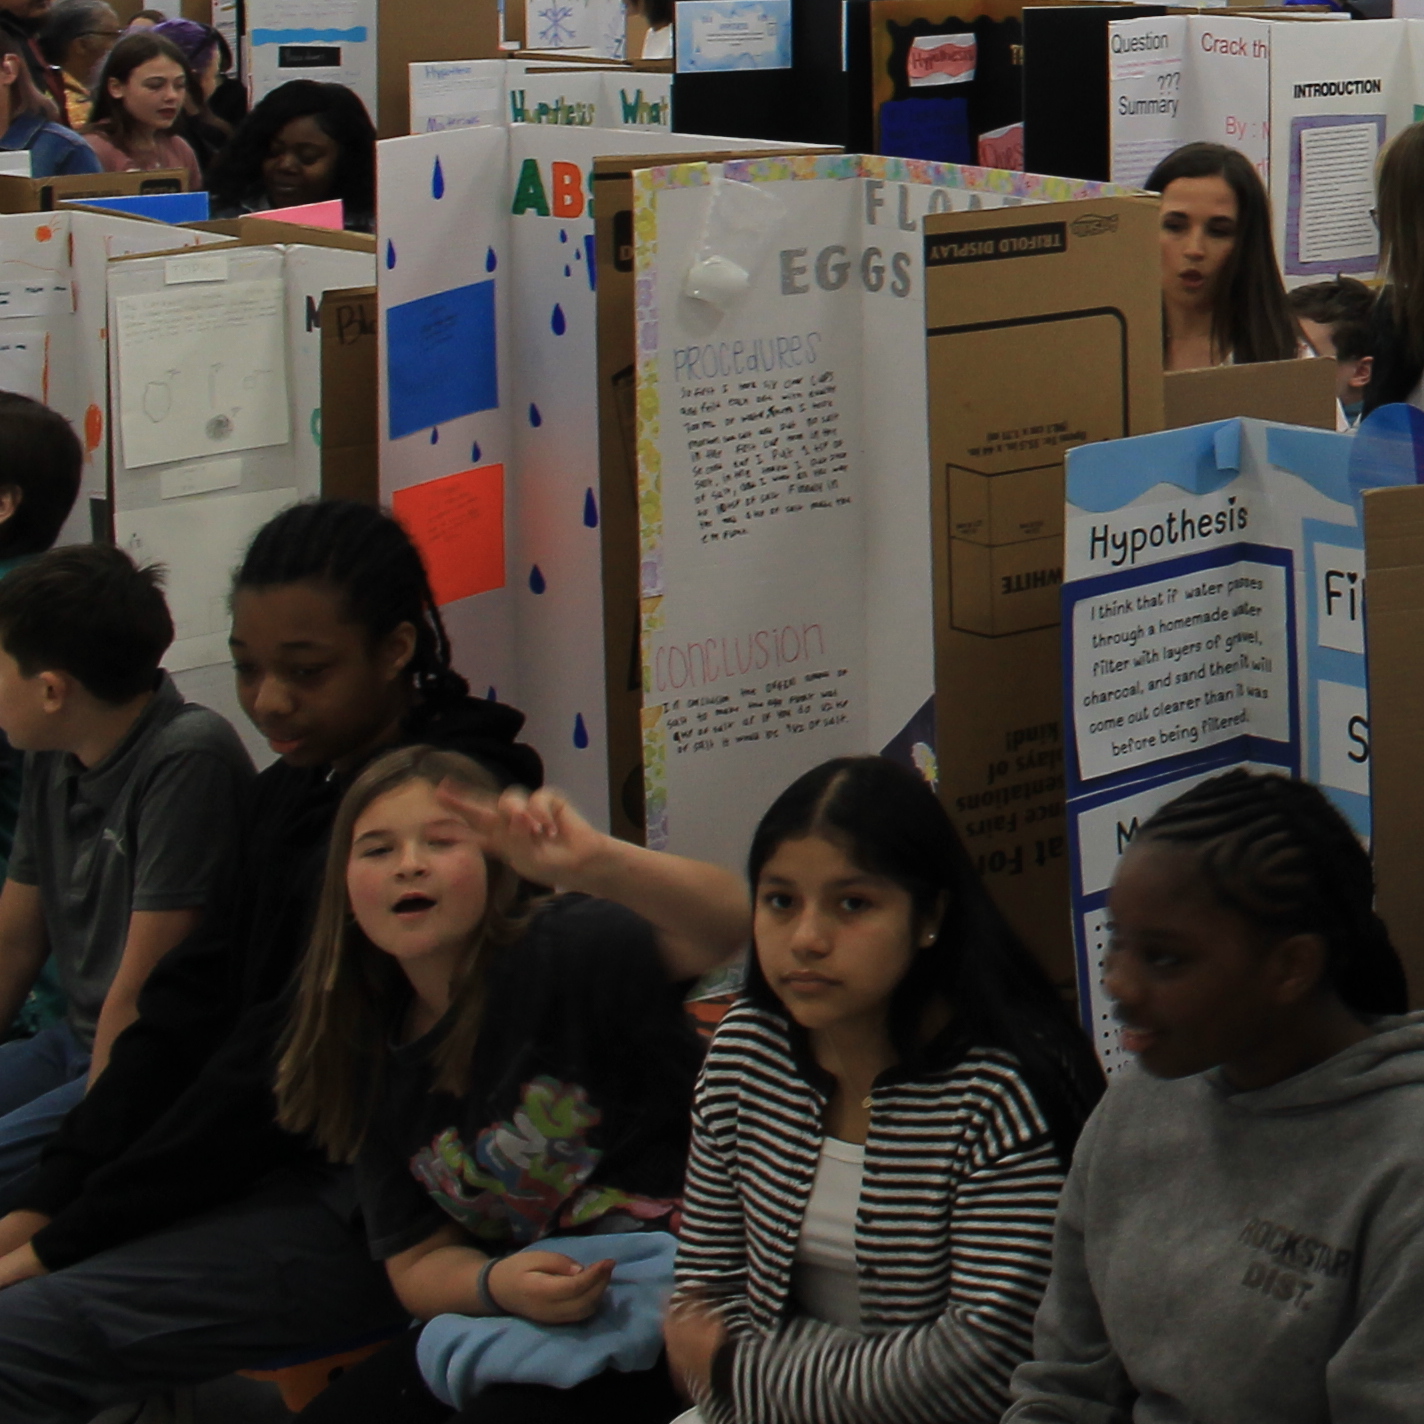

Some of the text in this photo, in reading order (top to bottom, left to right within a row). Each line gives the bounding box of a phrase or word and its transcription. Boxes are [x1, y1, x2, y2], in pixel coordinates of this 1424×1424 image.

[1111, 30, 1170, 55] Question
[1201, 32, 1248, 57] Crack
[1118, 95, 1180, 118] Summary
[1293, 78, 1382, 99] INTRODUCTION
[512, 158, 596, 219] AB
[928, 233, 1062, 261] TRIFOLD DISPLAY
[779, 244, 913, 298] EGGS
[1090, 496, 1249, 566] Hypothesis
[1099, 599, 1133, 620] think
[1136, 592, 1164, 612] that
[1166, 588, 1180, 604] if
[1184, 582, 1224, 601] water
[1092, 601, 1263, 649] through a homemade water
[1092, 656, 1132, 678] filter
[1133, 648, 1160, 668] with
[1163, 641, 1203, 663] layers
[1205, 634, 1222, 651] of
[1083, 680, 1145, 707] charcoal,
[1147, 673, 1172, 692] and
[1175, 663, 1206, 684] sand
[1251, 656, 1273, 673] will
[1089, 716, 1124, 735] come
[1127, 707, 1150, 723] out
[1152, 696, 1202, 719] clearer
[1204, 687, 1235, 706] than
[1246, 686, 1269, 700] was
[1005, 721, 1059, 752] kind!
[1112, 708, 1250, 757] before being filtered.
[986, 761, 1009, 785] of
[965, 811, 1018, 840] Fairs
